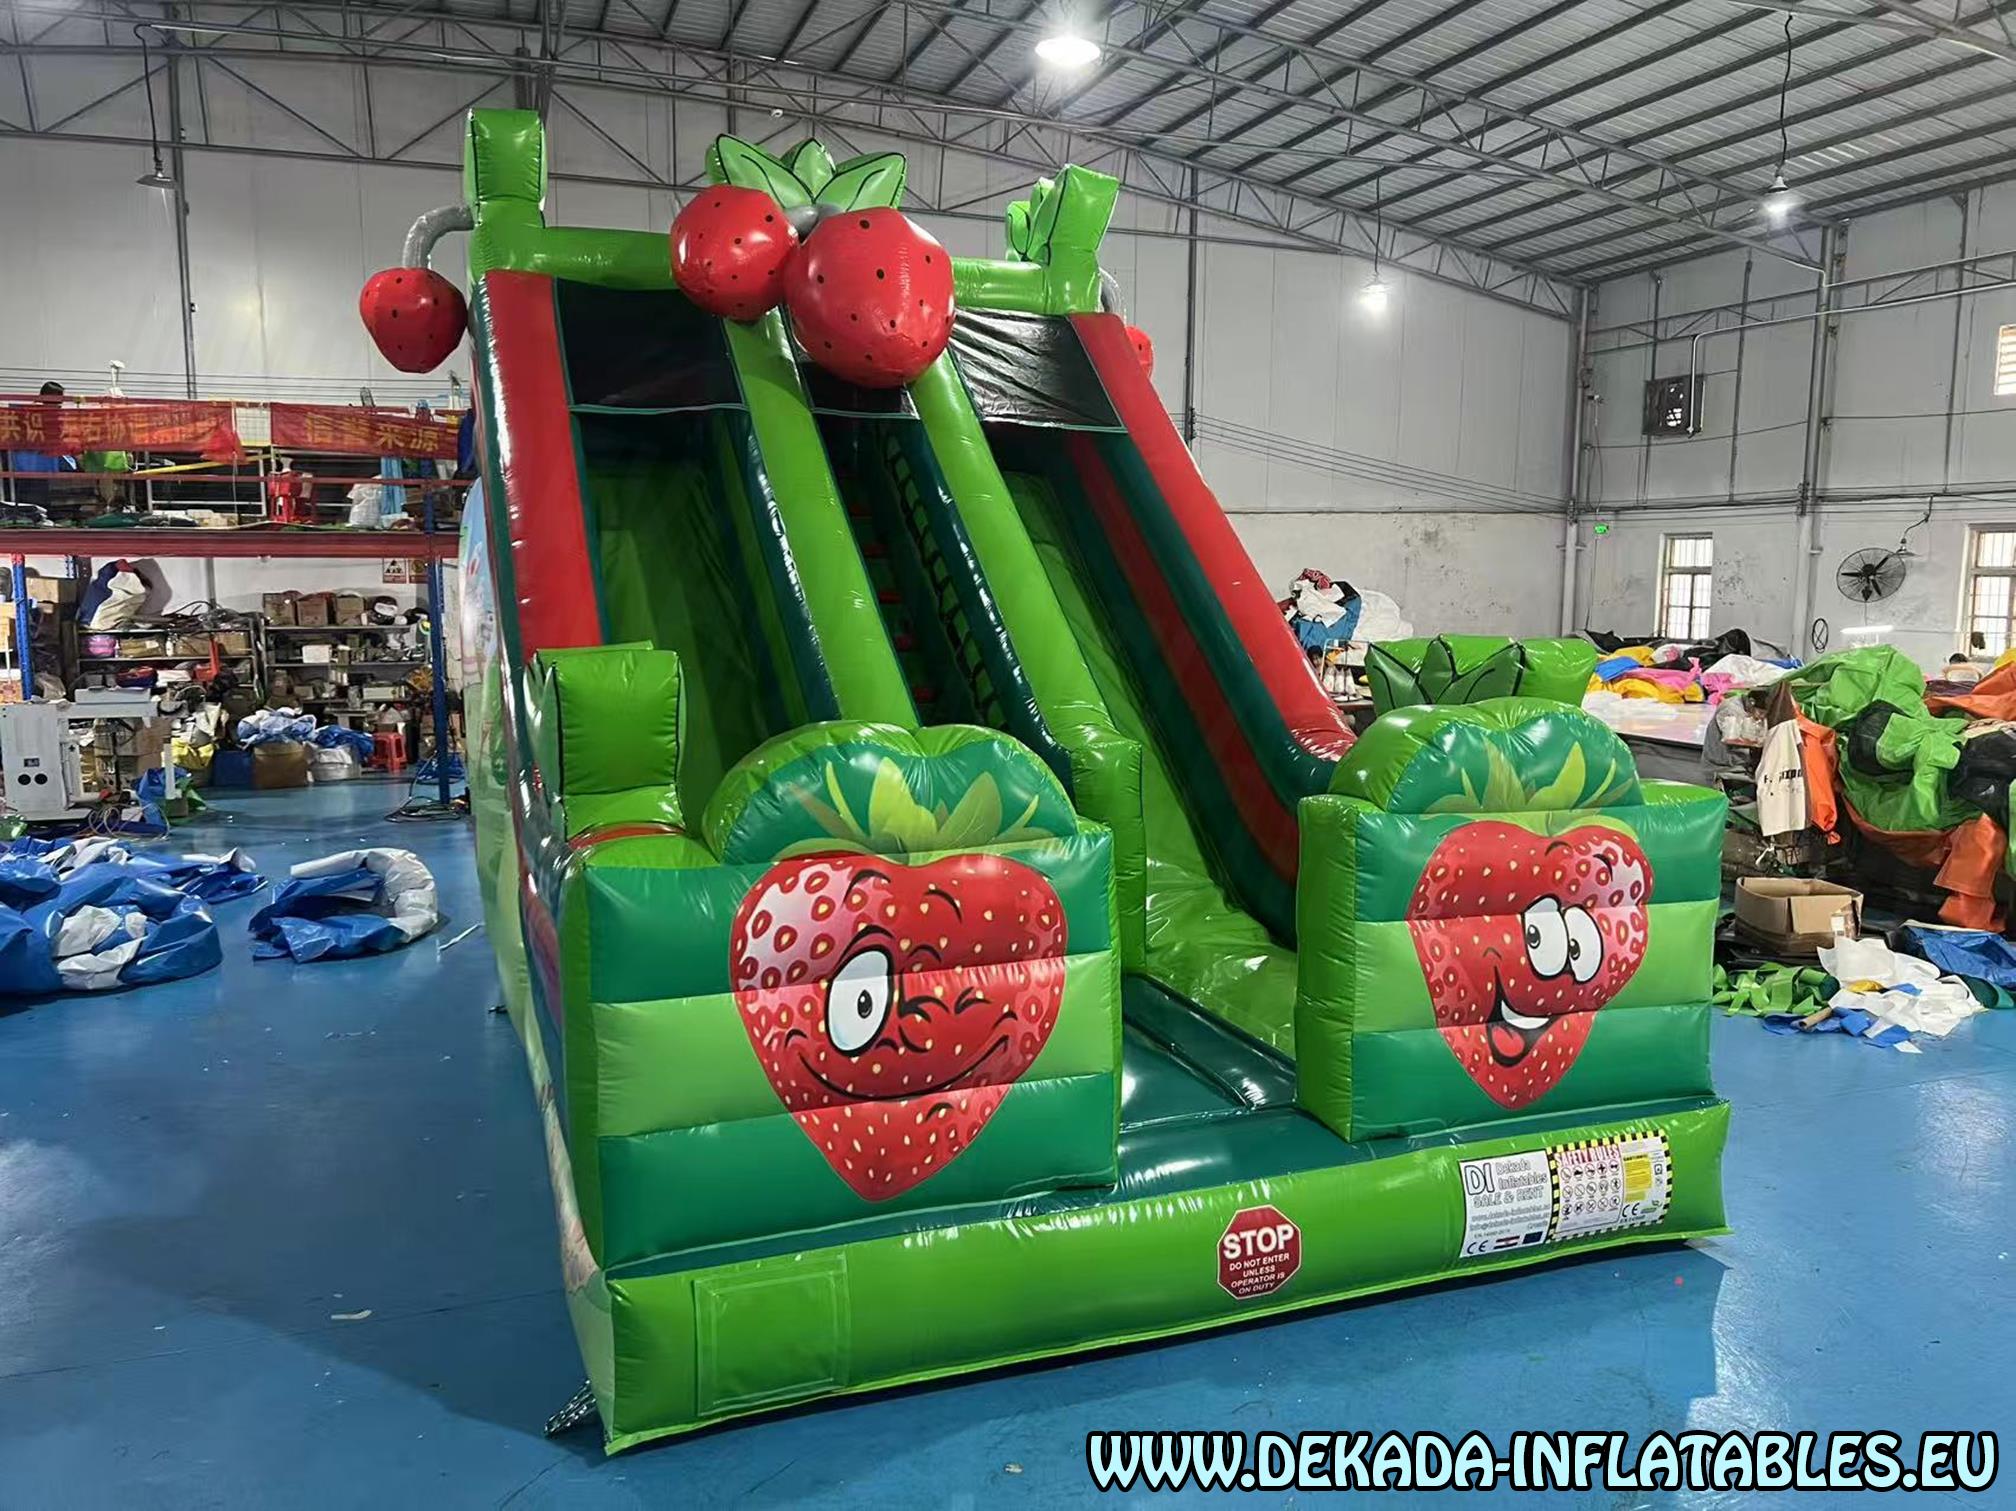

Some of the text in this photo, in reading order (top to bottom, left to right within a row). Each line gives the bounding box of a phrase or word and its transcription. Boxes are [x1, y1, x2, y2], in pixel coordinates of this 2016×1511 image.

[1553, 1143, 1619, 1167] SAFETY RULES
[1464, 1162, 1496, 1196] DI
[1473, 1191, 1502, 1208] SALE
[1503, 1190, 1515, 1204] &
[1223, 1223, 1294, 1260] STOP
[1229, 1253, 1290, 1271] DO NOT ENTER
[1231, 1272, 1286, 1288] OPERATOR IS
[1243, 1265, 1276, 1278] UNLESS
[1238, 1282, 1275, 1294] ON DUTY
